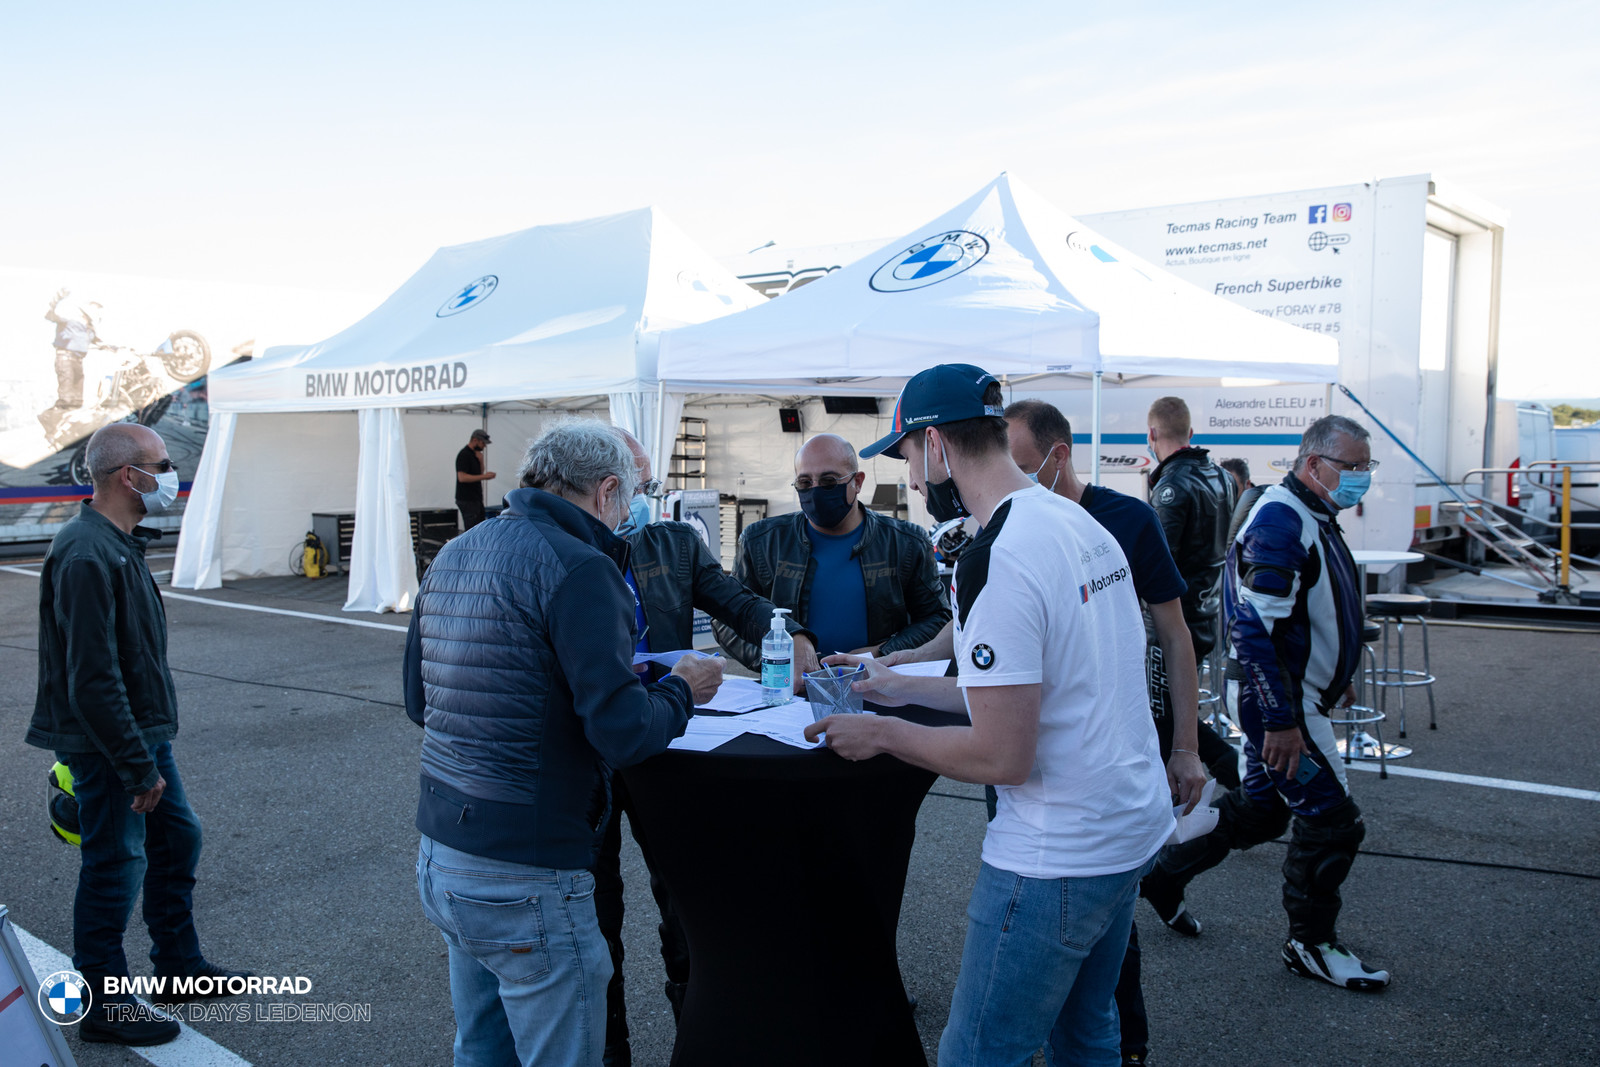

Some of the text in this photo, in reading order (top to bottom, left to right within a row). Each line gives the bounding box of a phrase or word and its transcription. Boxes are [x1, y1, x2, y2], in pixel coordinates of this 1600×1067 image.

[1166, 212, 1297, 235] Tecmas Racing Team
[1165, 238, 1268, 256] www.tecmas.net
[1188, 256, 1221, 265] Boutique
[1233, 253, 1251, 262] ligne
[1214, 275, 1343, 295] French Superbike
[1276, 304, 1316, 317] FORAY
[1318, 303, 1342, 314] #78
[1324, 321, 1341, 333] #5
[305, 361, 468, 398] BMW MOTORRAD
[1215, 398, 1266, 409] Alexandre
[1268, 397, 1306, 408] LELEU
[913, 414, 939, 422] MICHELIN
[1209, 416, 1251, 428] Baptiste
[1253, 416, 1306, 427] SANTILLI
[1099, 455, 1138, 466] Puig
